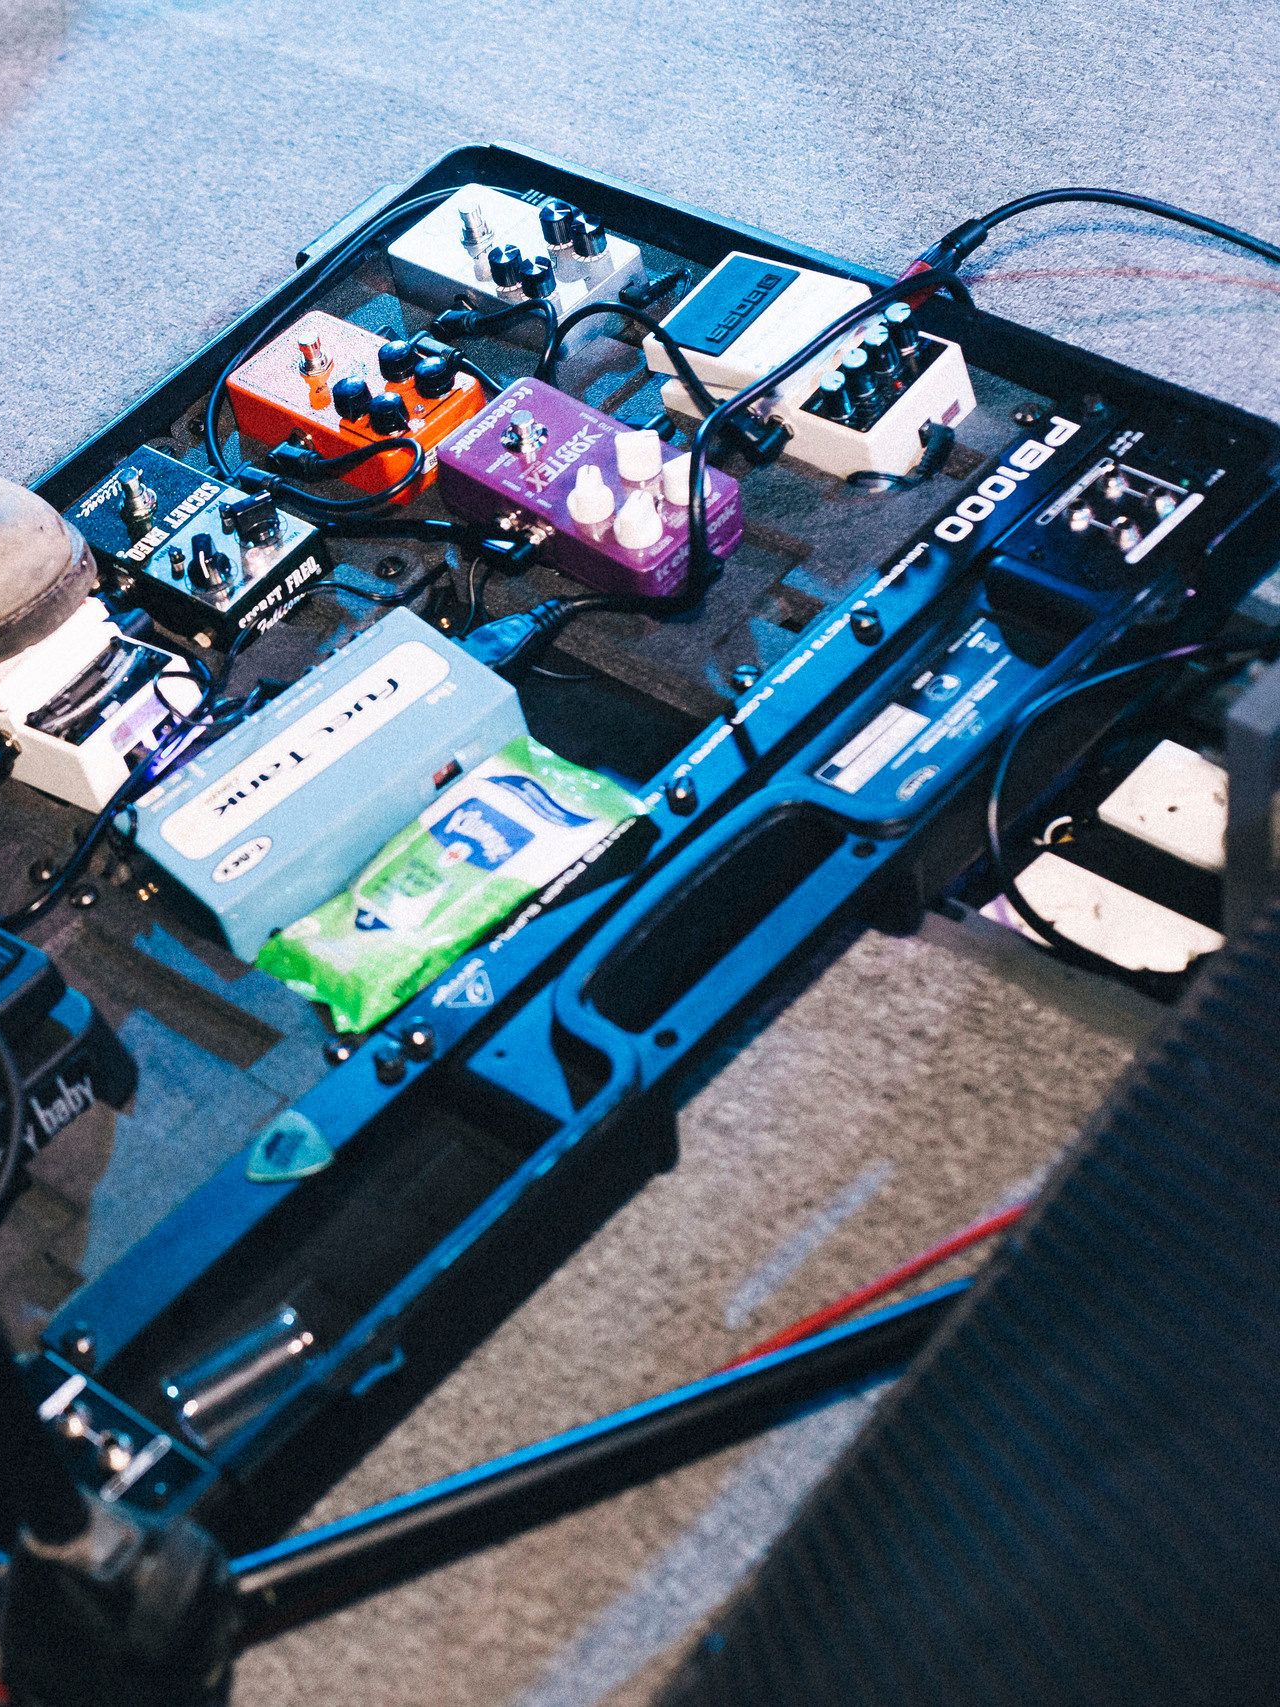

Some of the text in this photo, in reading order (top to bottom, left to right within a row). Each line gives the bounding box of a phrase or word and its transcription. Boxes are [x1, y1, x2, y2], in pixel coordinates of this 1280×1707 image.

[704, 285, 767, 345] BOSS
[448, 384, 533, 454] tc electronic
[521, 423, 603, 492] VORTEX
[931, 417, 1081, 546] PB1000
[163, 480, 220, 531] SECRET
[423, 679, 459, 706] the
[210, 750, 311, 818] Tank
[27, 1074, 95, 1135] baby
